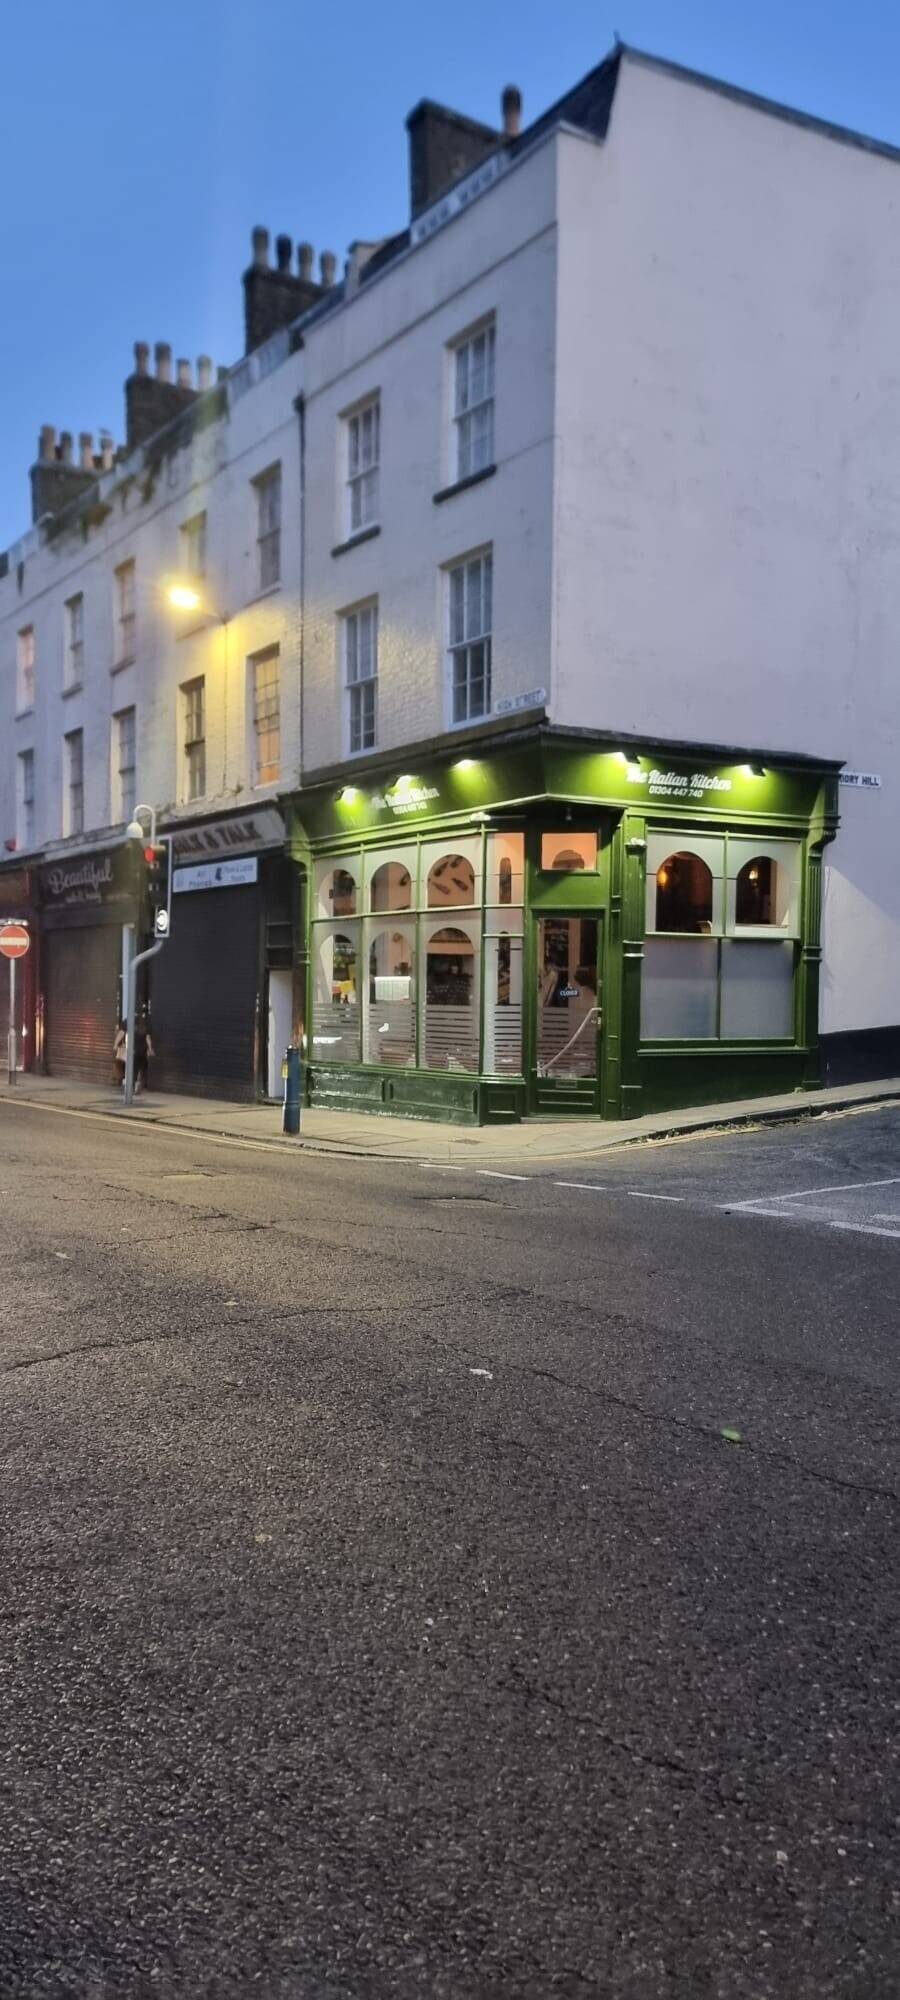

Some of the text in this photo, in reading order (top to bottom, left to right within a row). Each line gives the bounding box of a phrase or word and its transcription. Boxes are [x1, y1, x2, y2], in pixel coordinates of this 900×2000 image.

[626, 767, 732, 791] The Italian Kitchen
[861, 776, 879, 786] HILL
[648, 785, 704, 798] 01304 447 740
[215, 821, 263, 846] TALK
[48, 857, 114, 894] Beautiful
